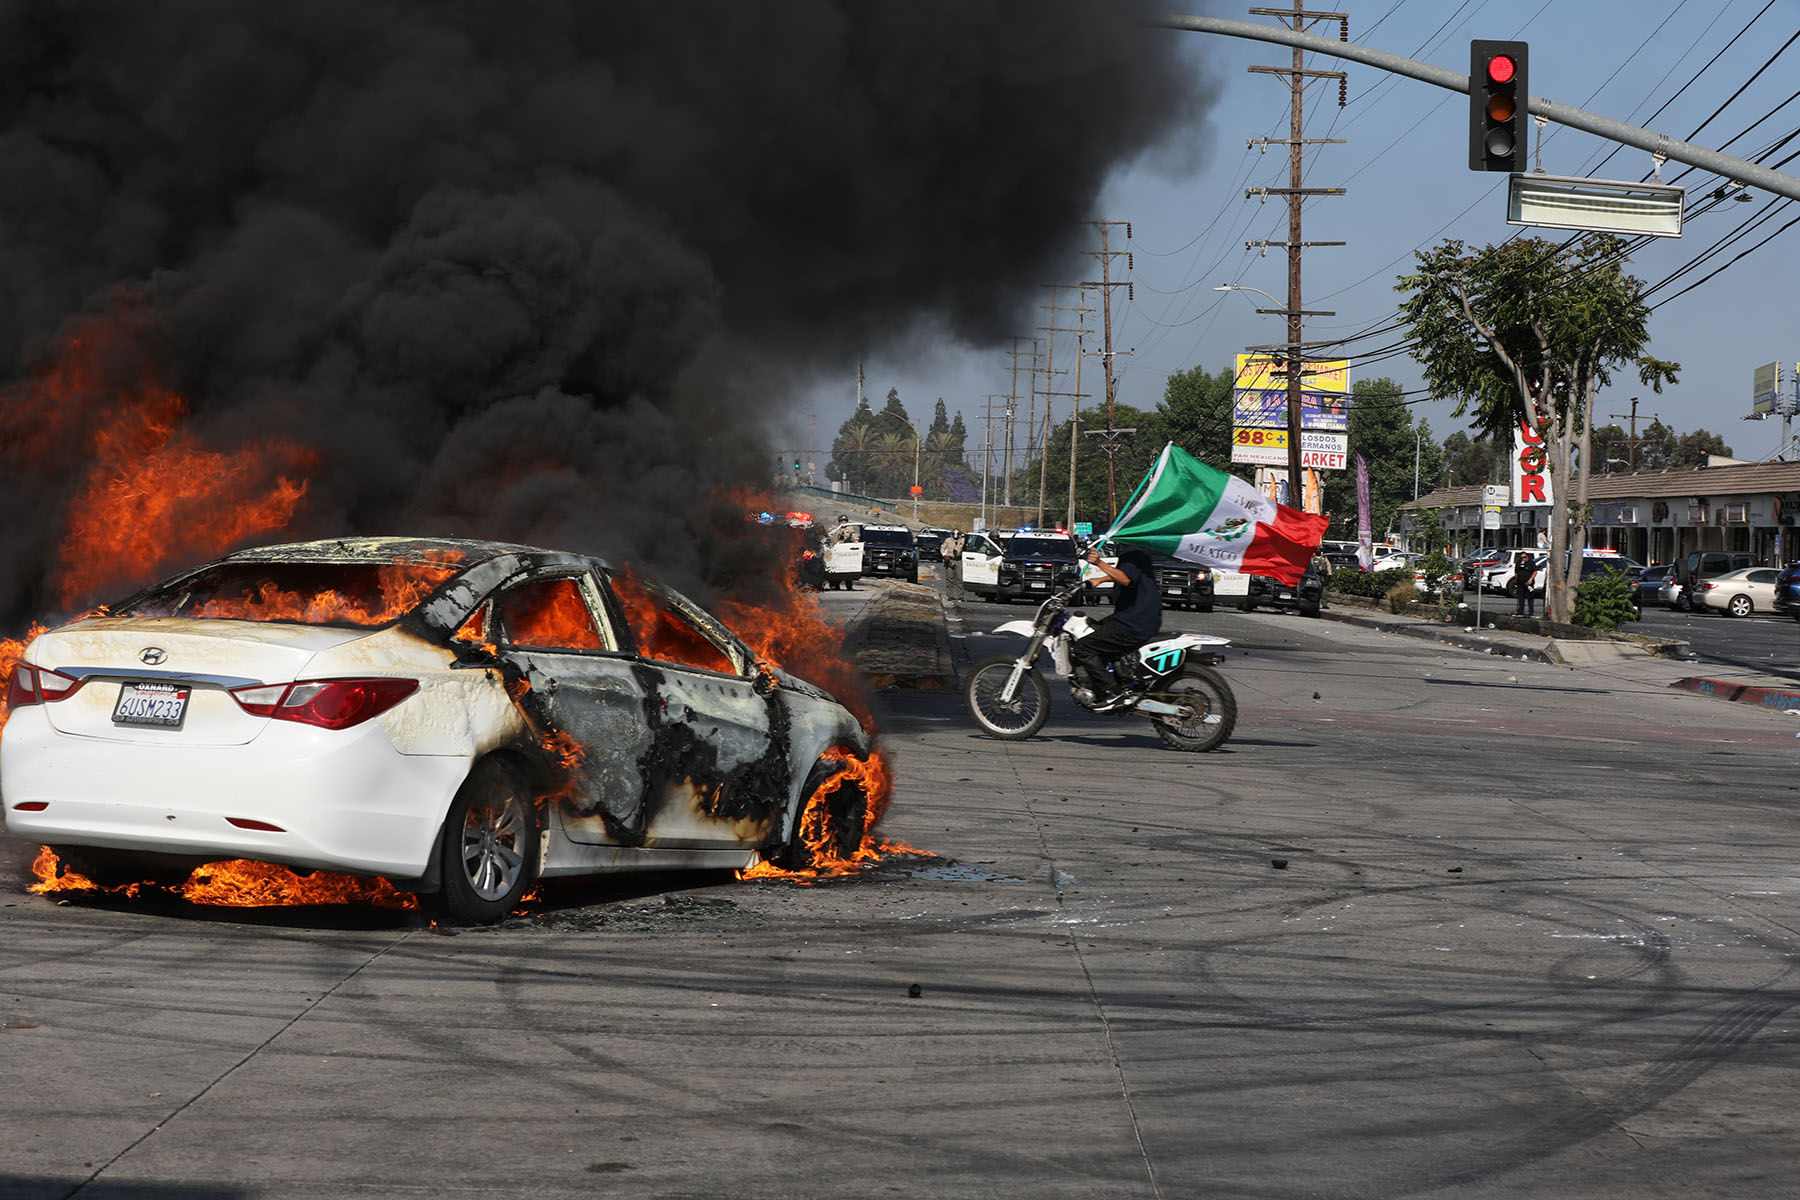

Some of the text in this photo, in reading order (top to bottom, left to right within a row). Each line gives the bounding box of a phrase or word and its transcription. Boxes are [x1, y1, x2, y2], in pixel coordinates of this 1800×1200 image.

[1301, 442, 1342, 450] ERMANOS
[1302, 452, 1344, 467] ARKET
[1188, 543, 1238, 561] MEXICO
[1152, 648, 1182, 672] 77
[138, 682, 175, 692] OXNARD
[119, 697, 182, 719] 6USM233
